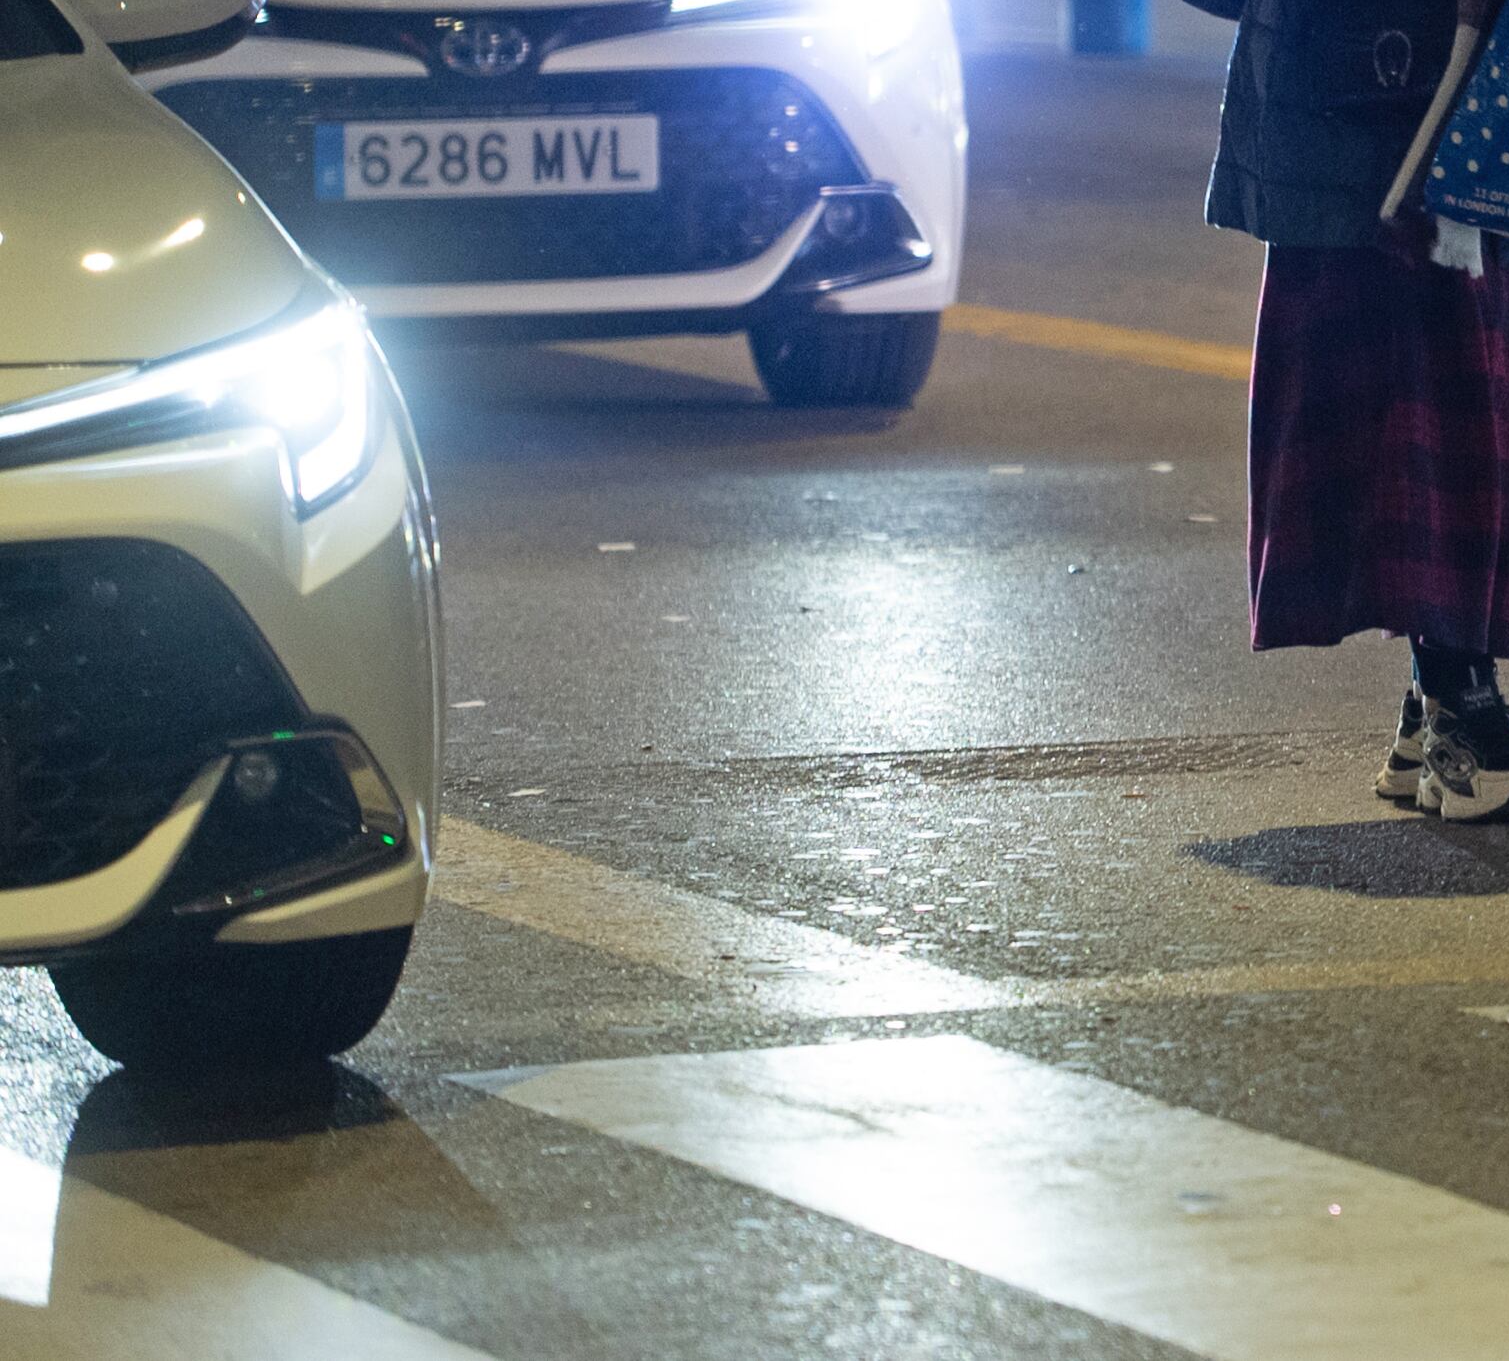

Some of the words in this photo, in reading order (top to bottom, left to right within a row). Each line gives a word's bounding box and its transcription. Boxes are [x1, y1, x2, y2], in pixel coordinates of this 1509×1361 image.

[358, 133, 508, 187] 6286
[532, 128, 640, 184] MVL
[1457, 198, 1506, 217] LONDON
